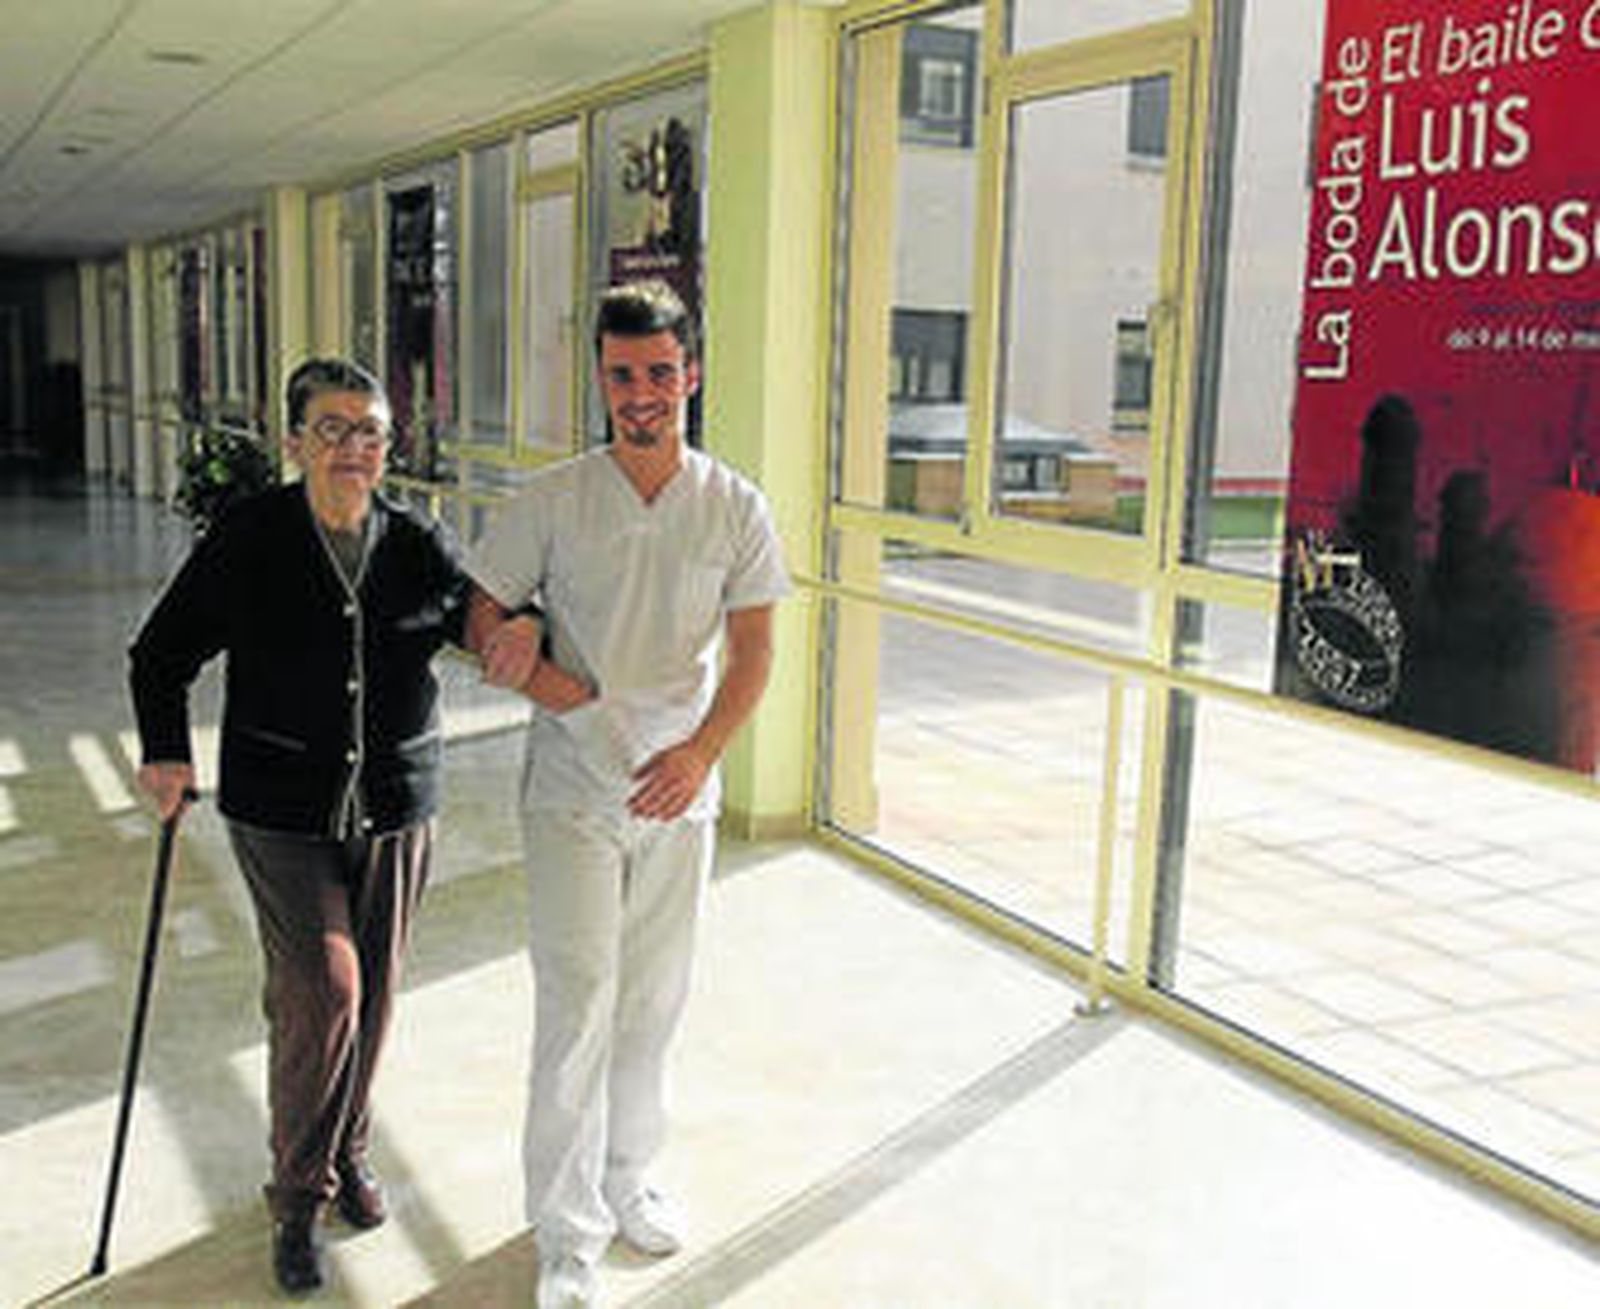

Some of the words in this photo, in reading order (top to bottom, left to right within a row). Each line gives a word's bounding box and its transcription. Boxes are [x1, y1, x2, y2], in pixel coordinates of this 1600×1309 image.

[1326, 37, 1370, 116] de
[1381, 21, 1423, 83] El
[1438, 0, 1565, 74] baile
[1380, 77, 1529, 180] Luis
[1309, 136, 1364, 289] boda
[1367, 187, 1600, 281] Alons
[1303, 309, 1352, 379] La
